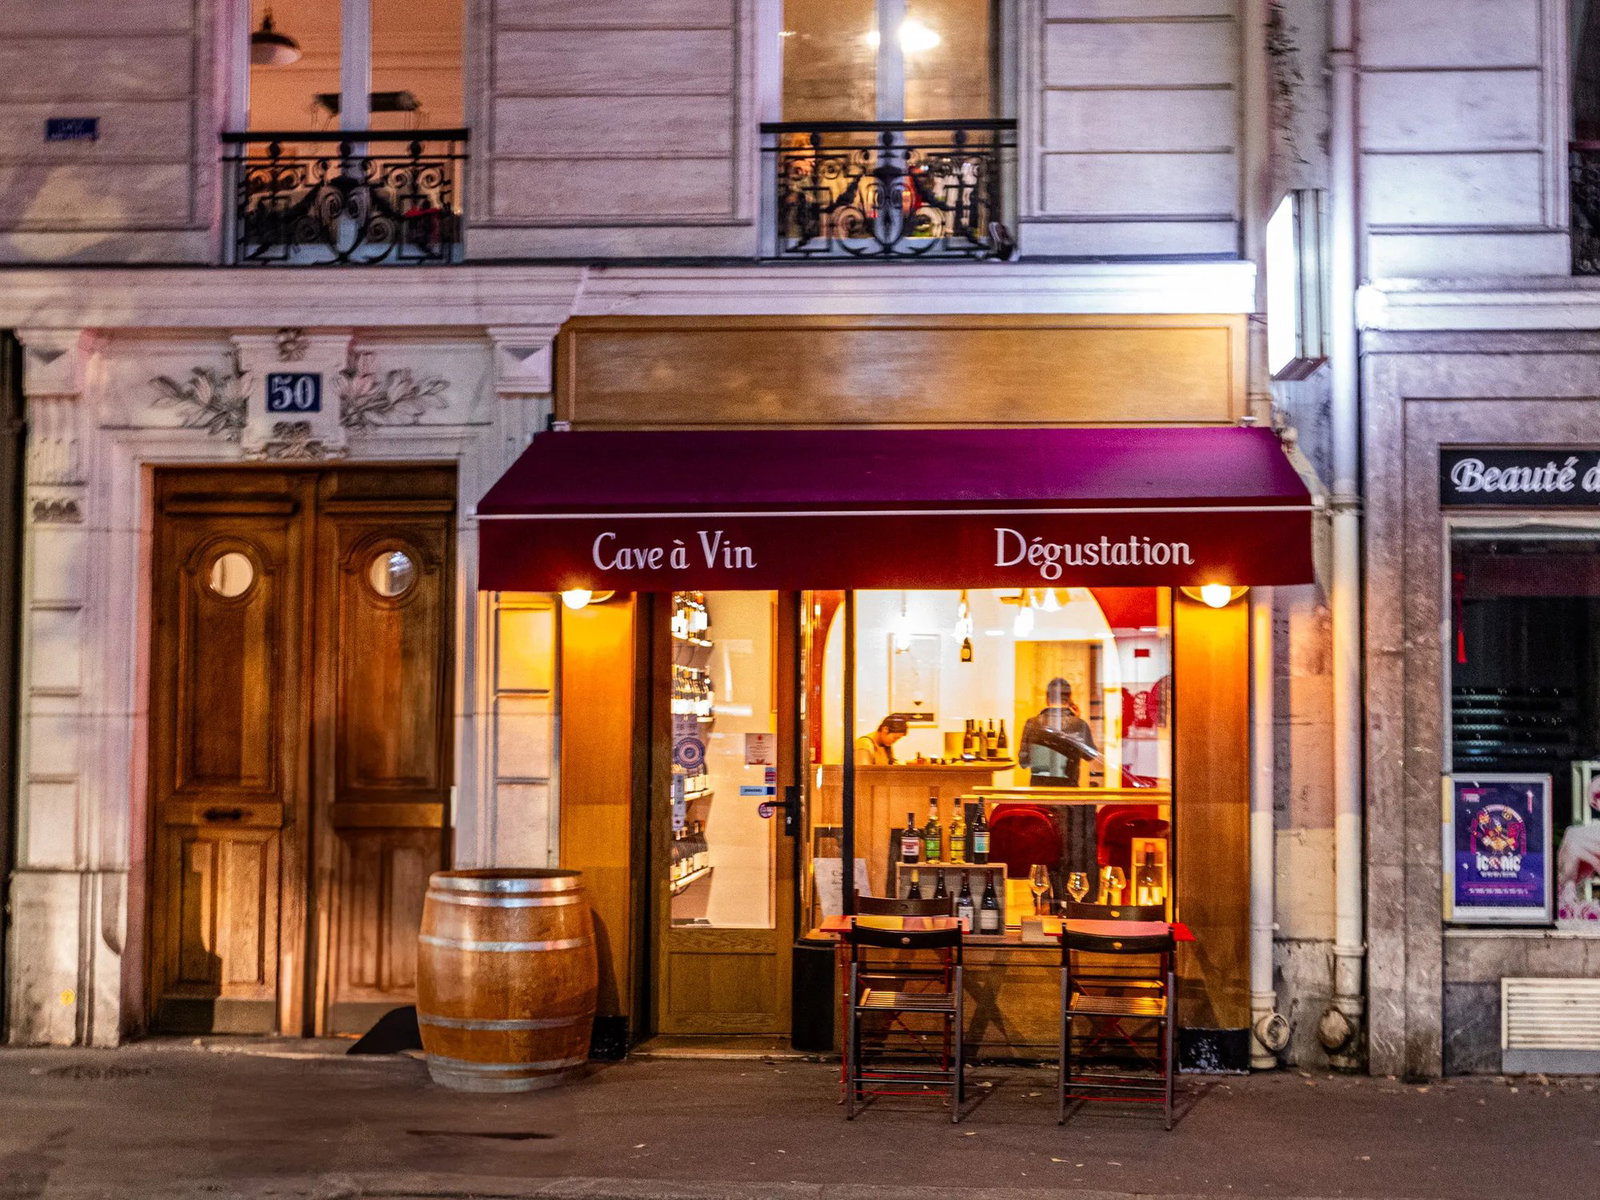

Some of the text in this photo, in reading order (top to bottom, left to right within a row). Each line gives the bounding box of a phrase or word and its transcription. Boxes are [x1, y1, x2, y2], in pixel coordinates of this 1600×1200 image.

[271, 375, 316, 410] 50
[1450, 455, 1580, 493] Beauté
[592, 530, 758, 571] Cave à Vin
[993, 527, 1196, 580] Dégustation
